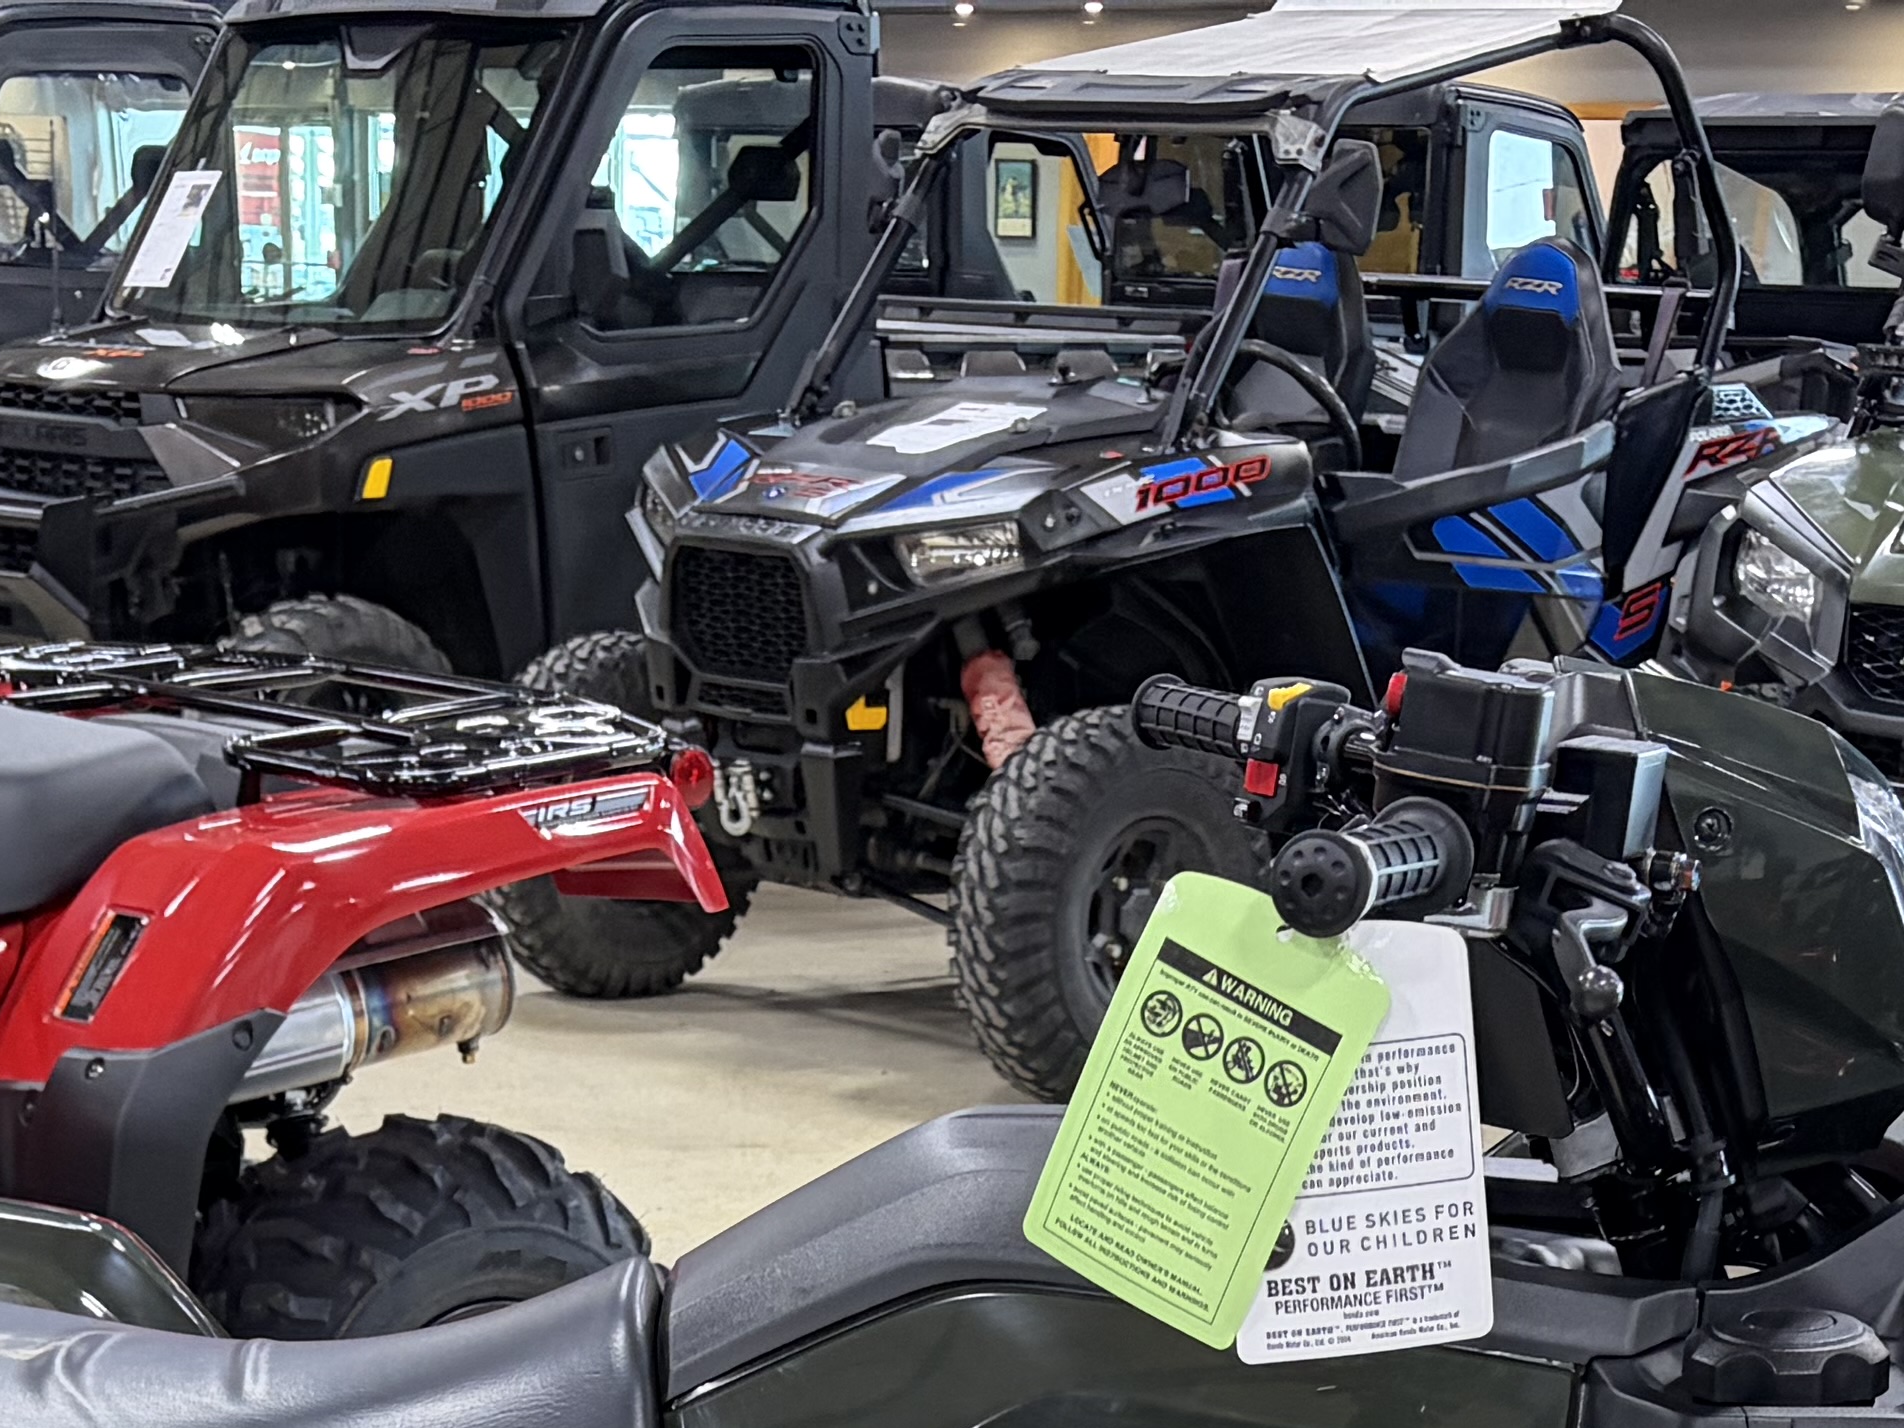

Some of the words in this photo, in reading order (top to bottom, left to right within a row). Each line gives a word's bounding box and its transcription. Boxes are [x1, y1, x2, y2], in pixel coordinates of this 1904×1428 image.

[1505, 277, 1563, 296] RZR
[376, 374, 499, 421] XP
[1135, 454, 1272, 513] 1000
[537, 798, 595, 822] IRS
[1220, 973, 1294, 1027] WARNING
[1377, 1043, 1456, 1064] performance
[1354, 1065, 1391, 1080] that's
[1396, 1062, 1420, 1076] why
[1392, 1075, 1442, 1092] position
[1342, 1098, 1361, 1111] the
[1366, 1089, 1447, 1108] environment.
[1380, 1103, 1462, 1122] low-emission
[1338, 1130, 1358, 1141] our
[1362, 1122, 1409, 1139] current
[1414, 1119, 1436, 1132] and
[1314, 1145, 1351, 1160] sports
[1356, 1138, 1415, 1156] products.
[1329, 1158, 1354, 1172] kind
[1360, 1156, 1371, 1169] of
[1377, 1148, 1455, 1168] performance
[1302, 1178, 1323, 1190] can
[1328, 1170, 1398, 1188] appreciate.
[1305, 1215, 1357, 1235] BLUE
[1365, 1207, 1426, 1229] SKIES
[1434, 1201, 1474, 1220] FOR
[1307, 1239, 1351, 1257] OUR
[1360, 1223, 1476, 1251] CHILDREN
[1266, 1275, 1321, 1298] BEST
[1329, 1271, 1356, 1291] ON
[1275, 1291, 1382, 1315] PERFORMANCE
